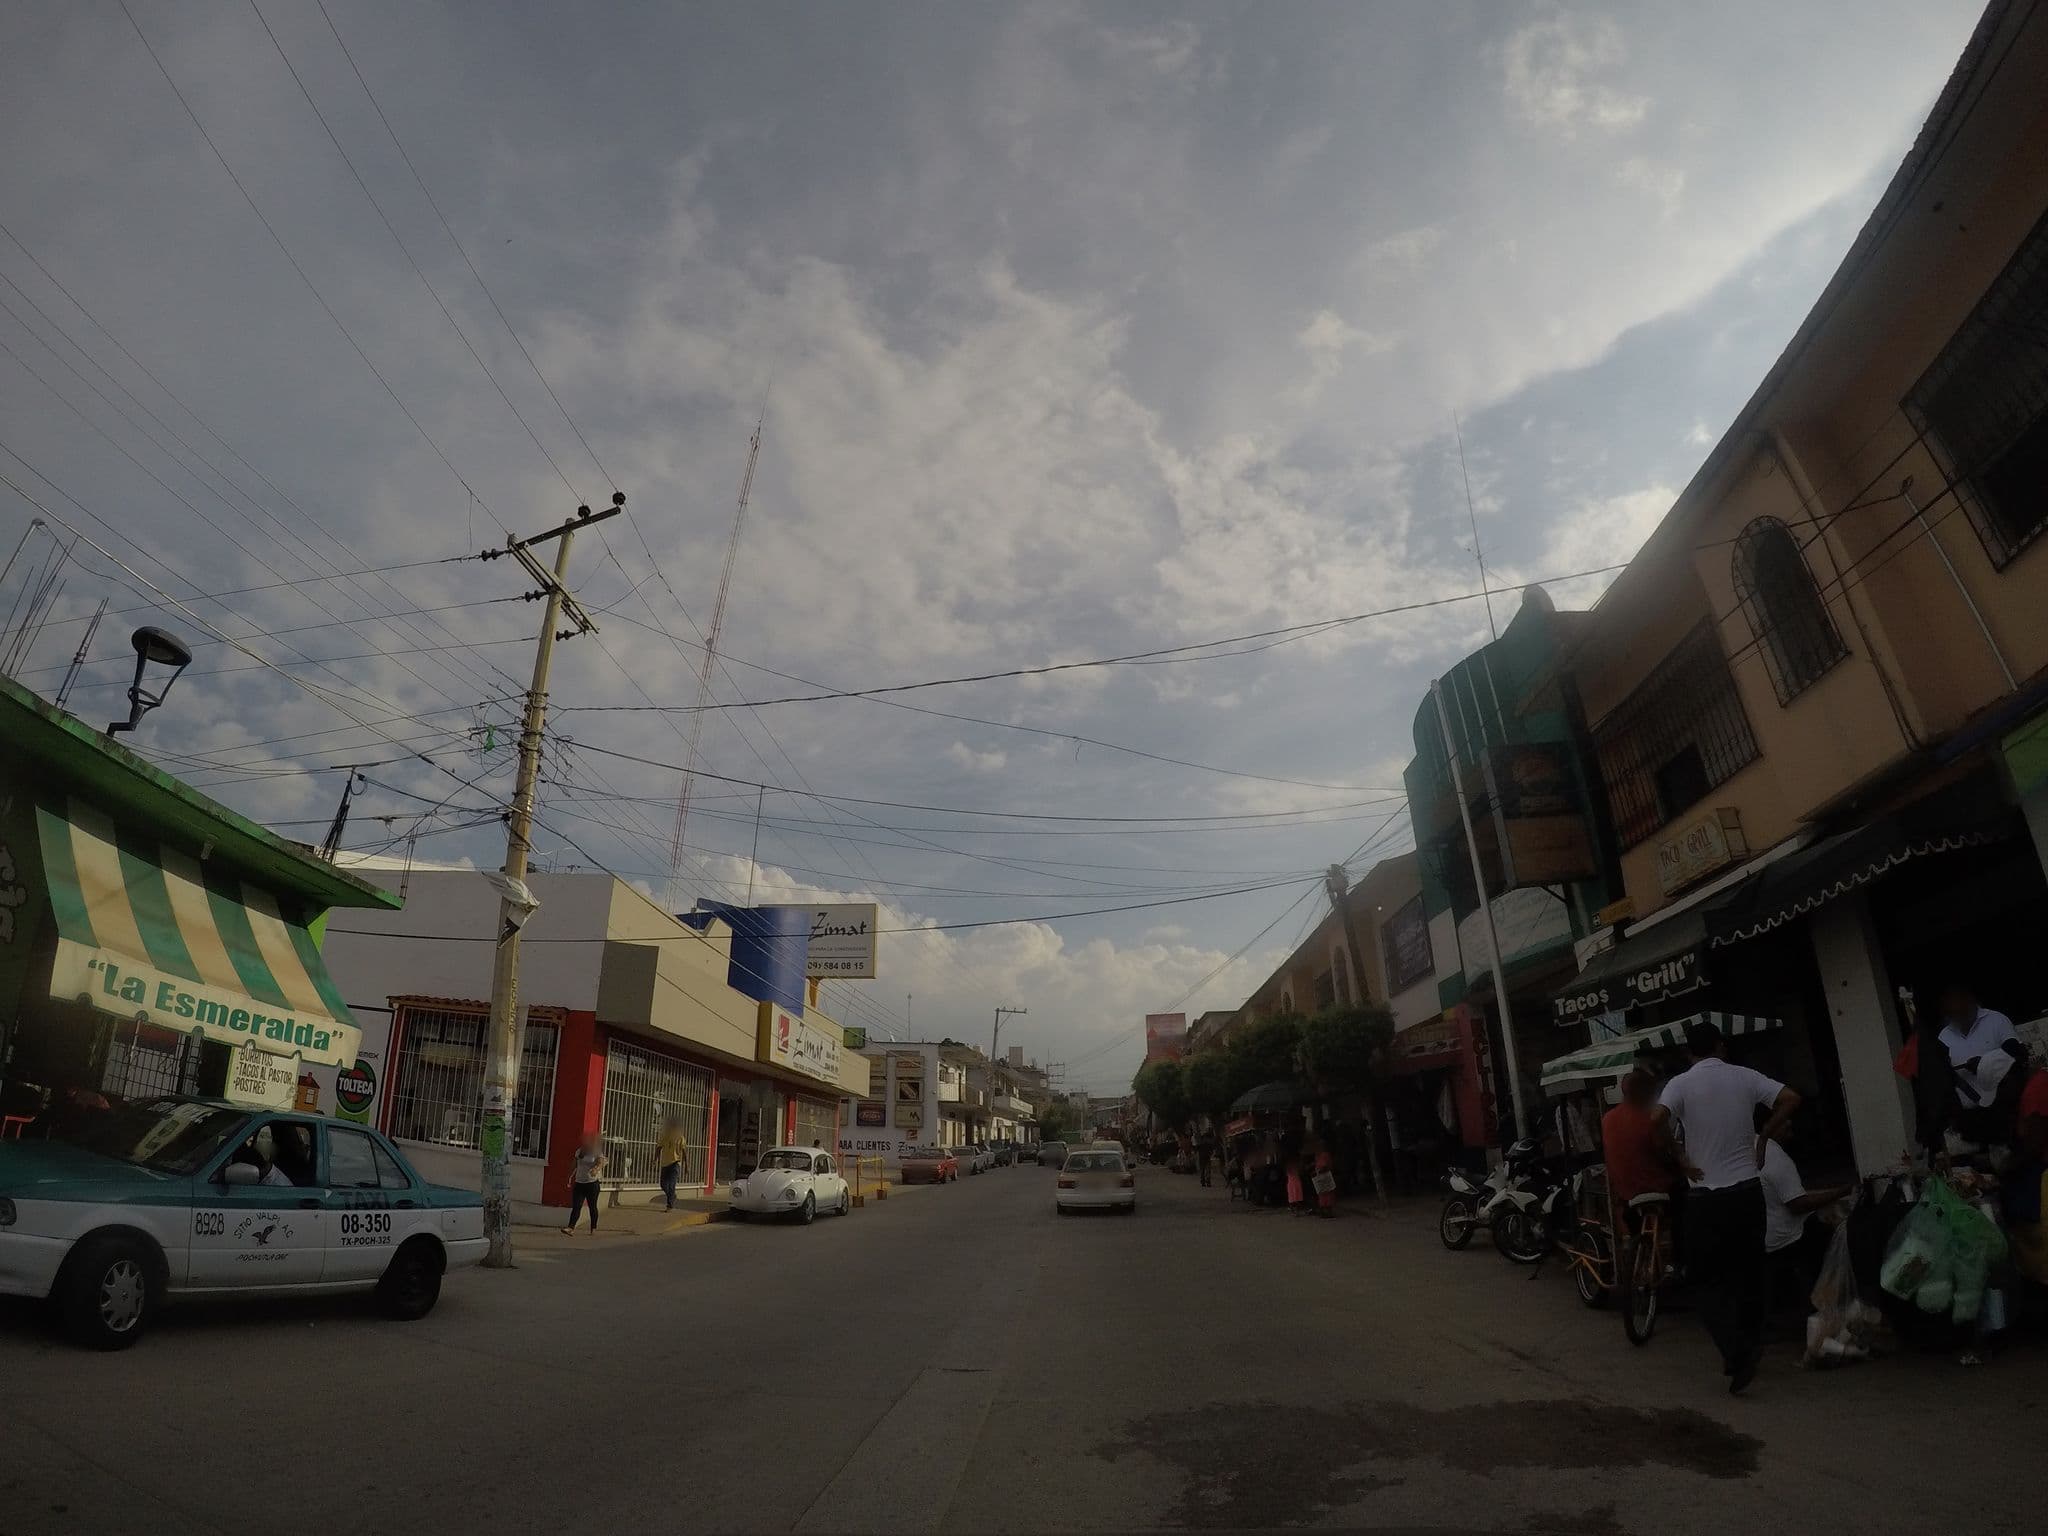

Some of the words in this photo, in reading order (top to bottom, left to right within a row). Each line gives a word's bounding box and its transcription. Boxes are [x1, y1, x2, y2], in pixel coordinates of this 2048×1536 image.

[807, 911, 868, 942] Zimat
[807, 961, 821, 970] 09)
[823, 961, 839, 970] 584
[840, 961, 851, 970] 08
[854, 961, 865, 970] 15
[88, 959, 147, 1004] “La
[155, 981, 344, 1051] Esmeralda”
[1554, 989, 1610, 1016] Tacos
[792, 1021, 824, 1061] Zimat
[358, 1051, 379, 1060] EMEX
[239, 1062, 260, 1079] TACOS
[234, 1077, 267, 1095] POSTRES
[338, 1077, 374, 1096] TOLTECA
[838, 1140, 853, 1151] ARA
[856, 1140, 891, 1151] CLIENTES
[337, 1190, 391, 1210] TAXI
[195, 1212, 225, 1235] 8928
[341, 1213, 391, 1233] 08-350
